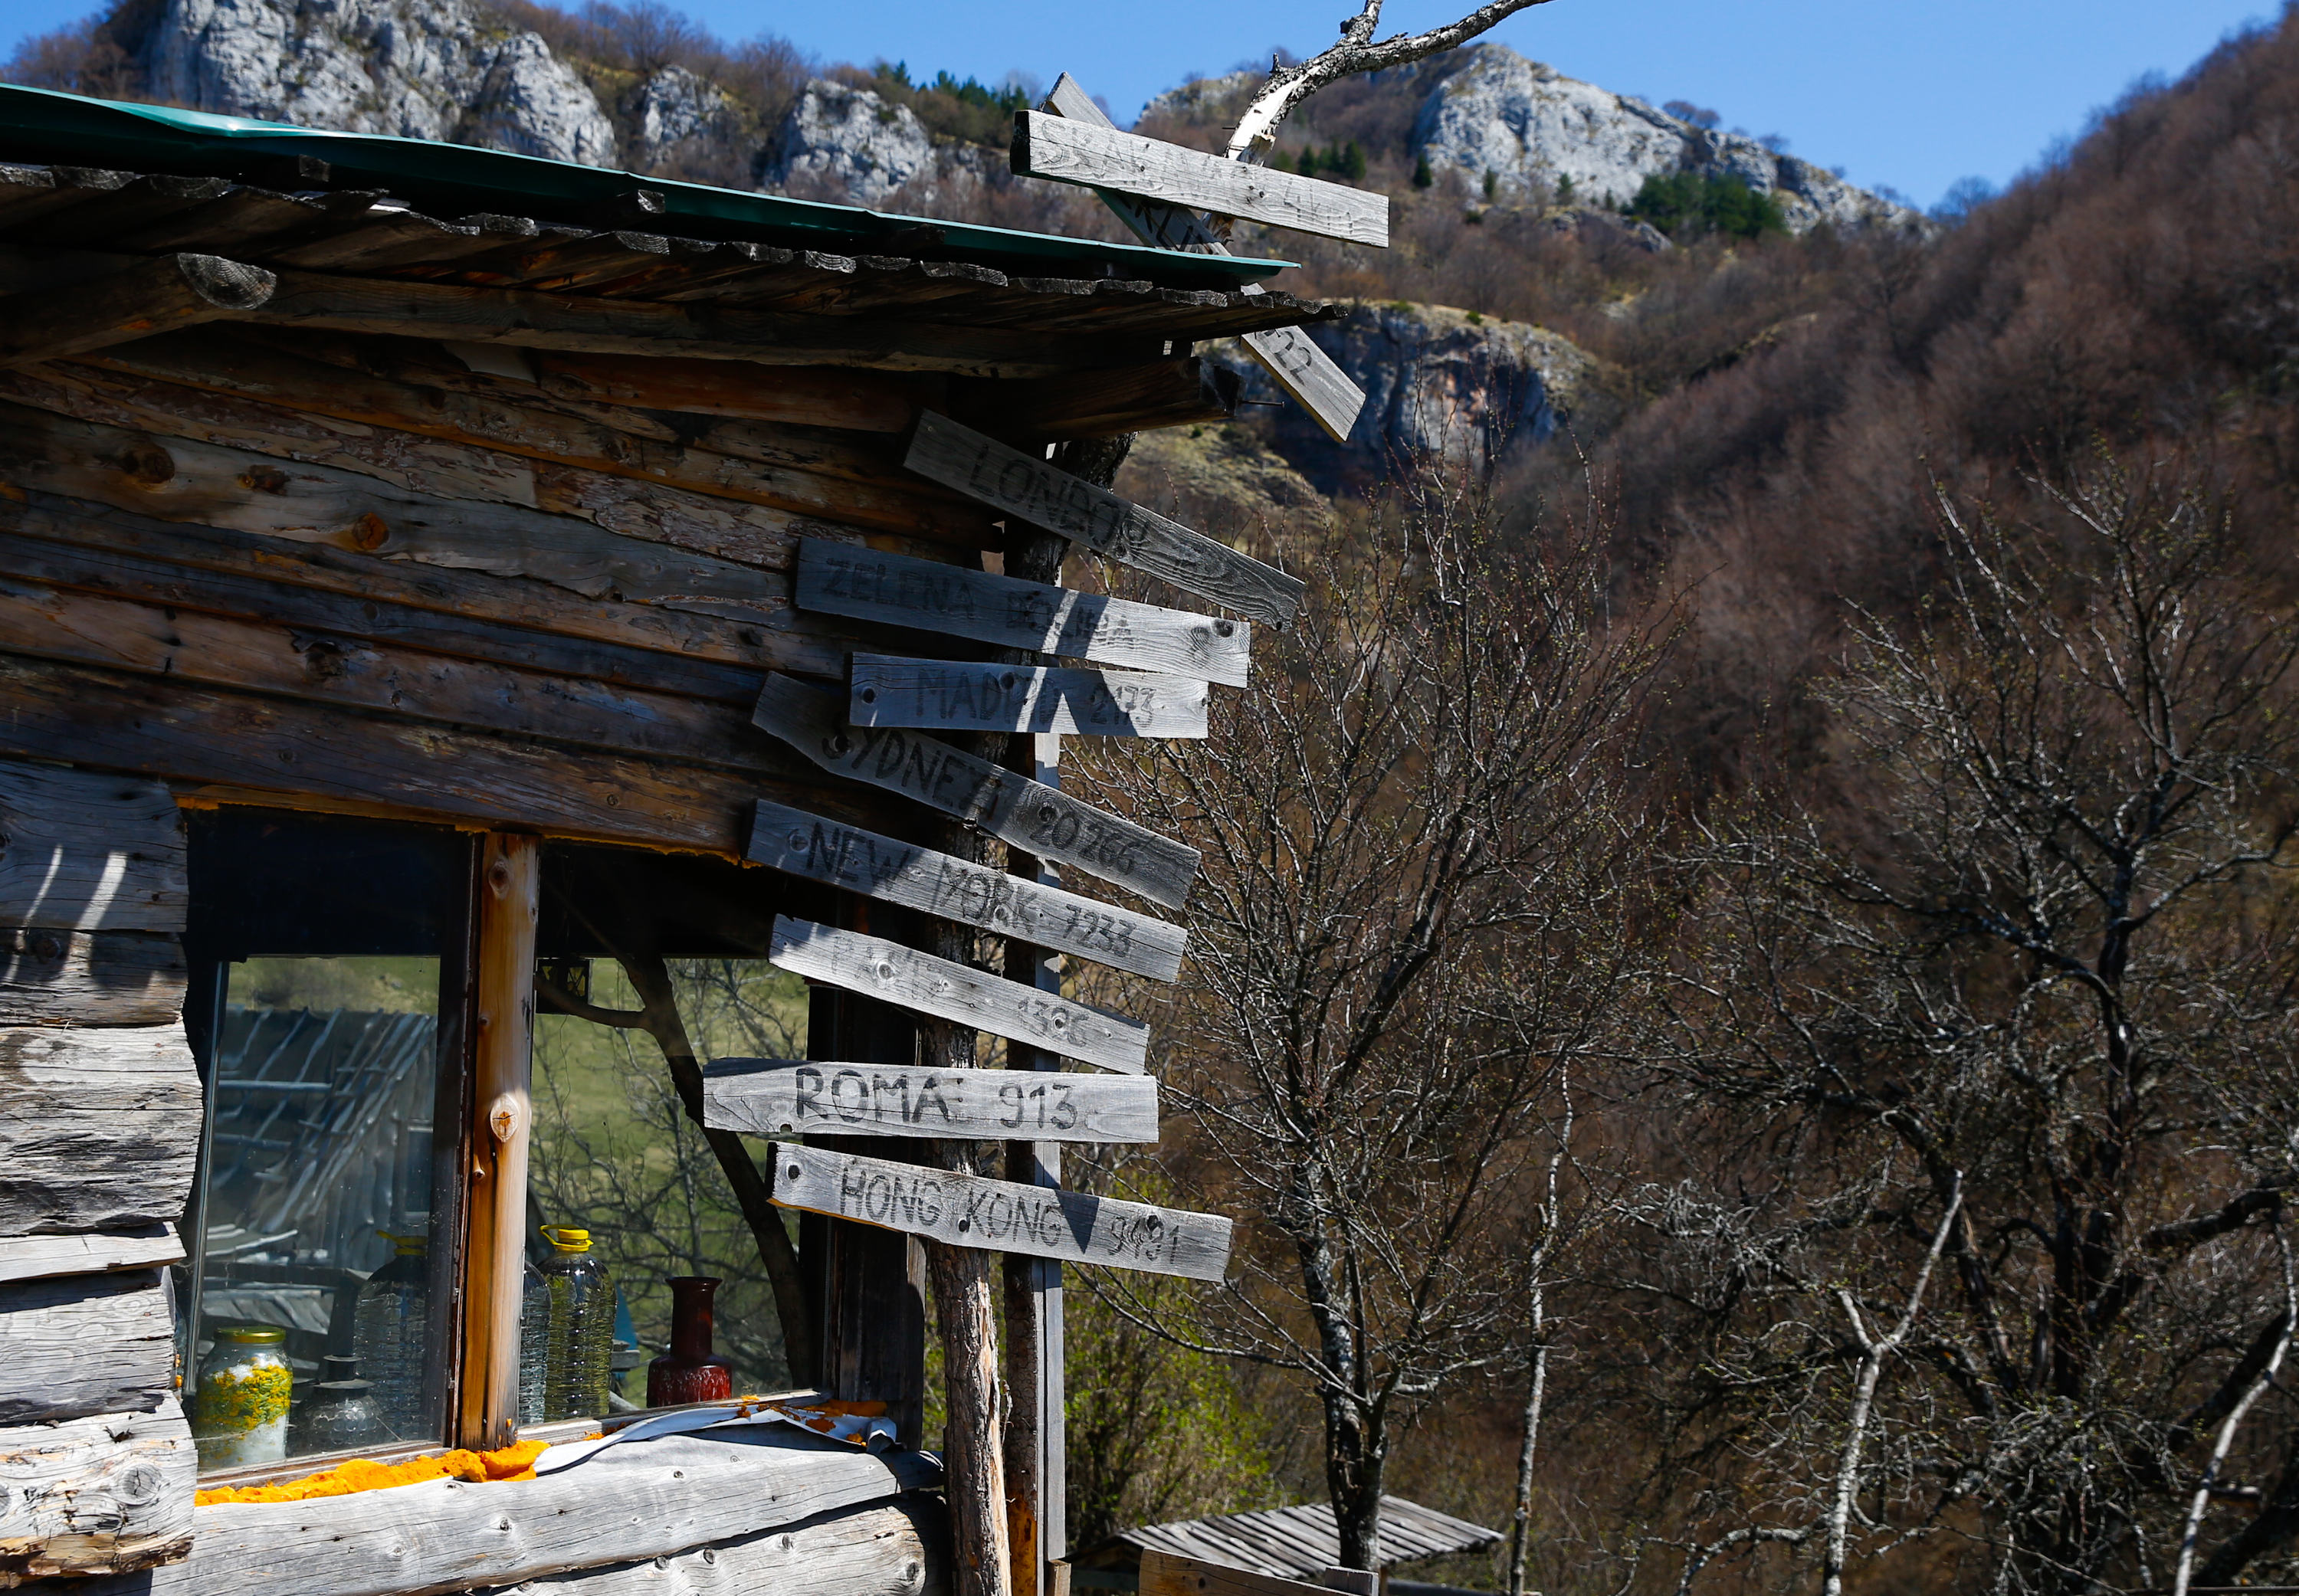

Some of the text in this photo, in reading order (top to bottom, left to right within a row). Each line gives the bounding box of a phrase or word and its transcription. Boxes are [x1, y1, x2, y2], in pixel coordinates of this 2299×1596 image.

[968, 442, 1149, 555] LONDON
[821, 557, 975, 620] ZELENA
[917, 667, 1157, 729] MADRID 2173
[806, 822, 1136, 958] NEW YORK 7233
[795, 1067, 1078, 1130] ROMA 913
[840, 1166, 941, 1226] HONG
[963, 1188, 1062, 1247] KONG
